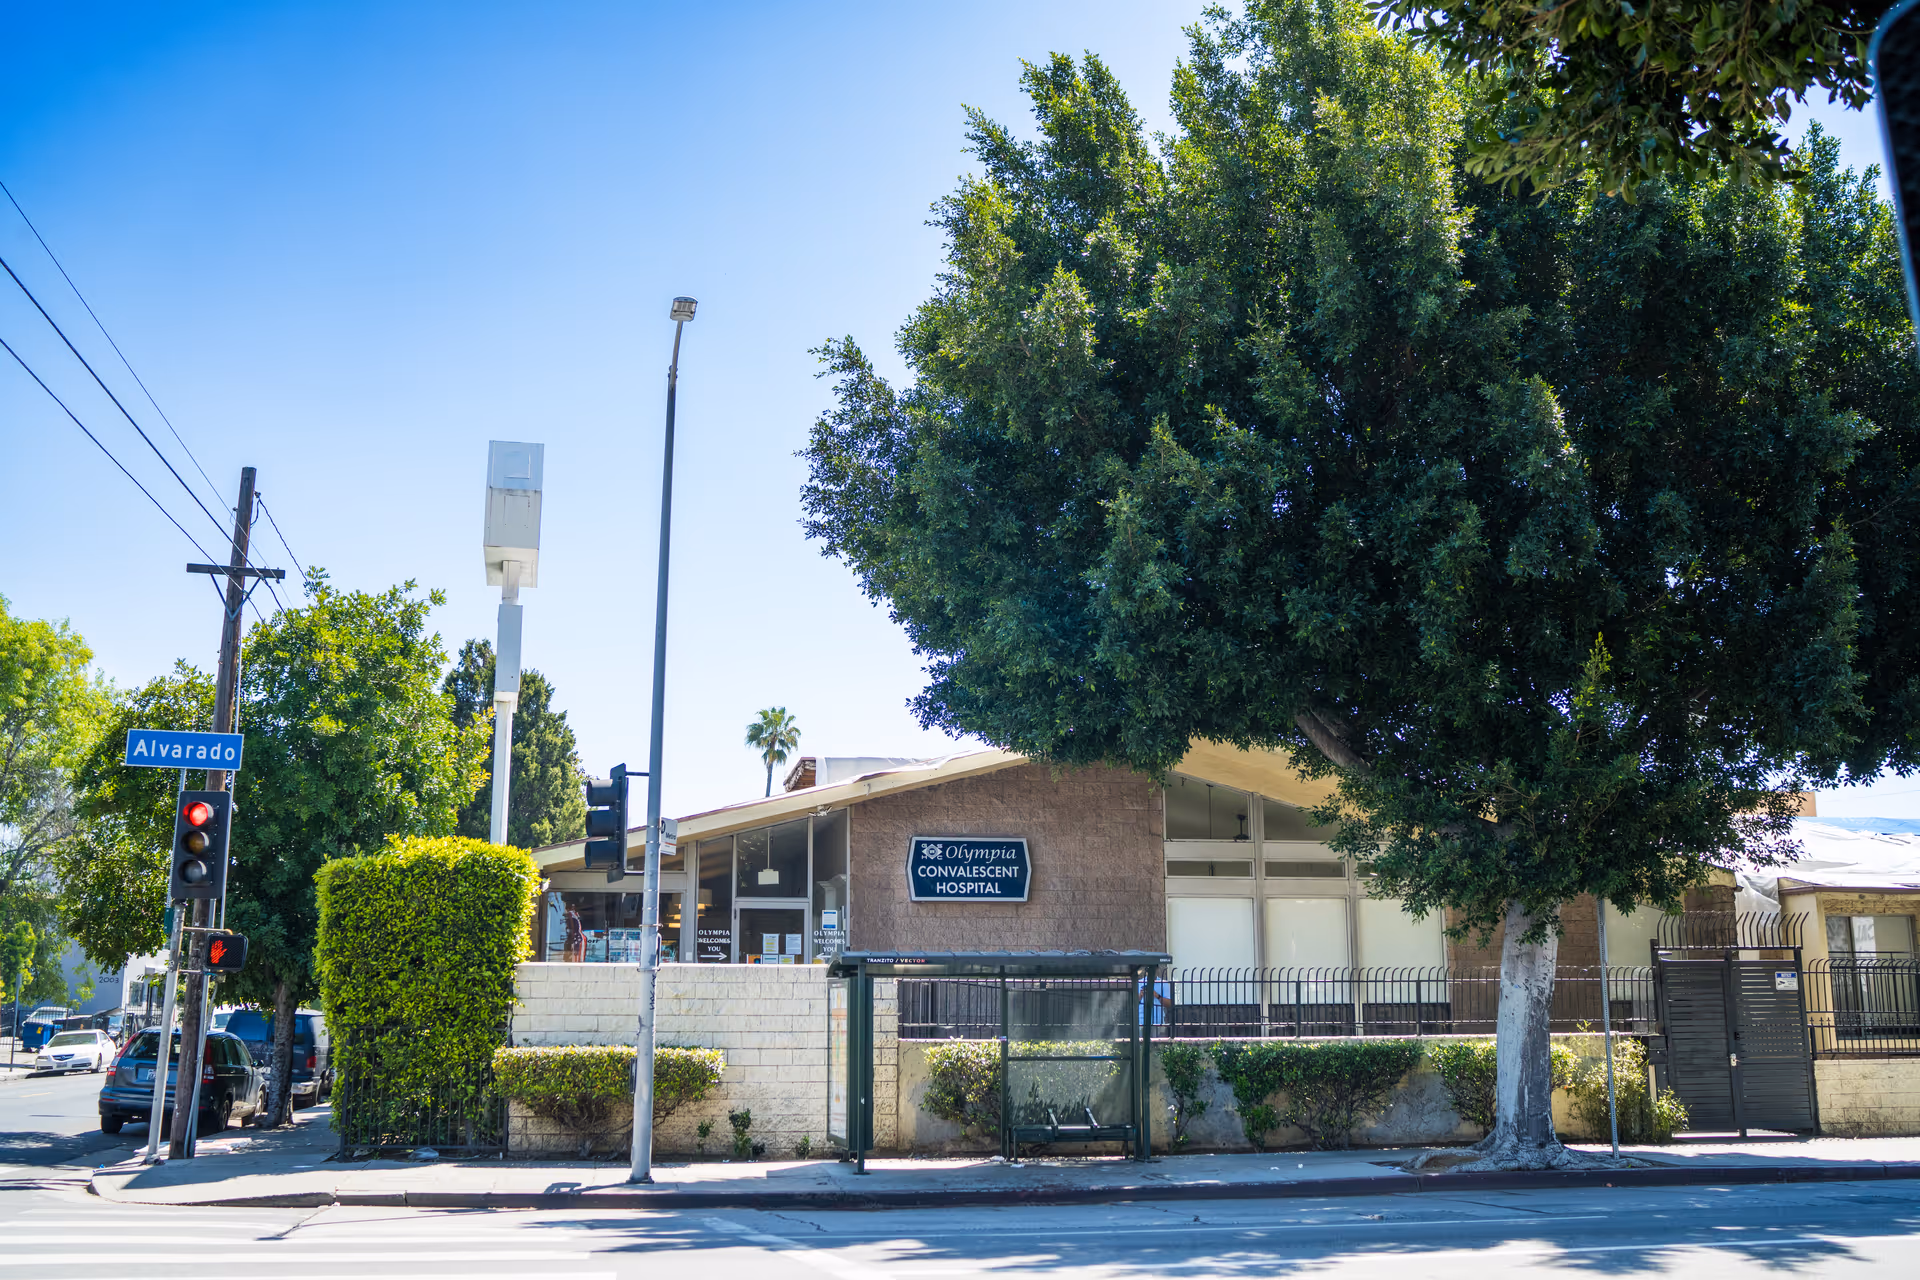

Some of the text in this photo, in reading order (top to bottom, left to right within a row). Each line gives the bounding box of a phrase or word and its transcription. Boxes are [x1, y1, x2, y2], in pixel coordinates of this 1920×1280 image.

[133, 739, 235, 761] Alvarado
[945, 843, 1017, 864] Olympia
[917, 865, 1019, 878] CONVALESCENT
[936, 882, 1001, 894] HOSPITAL
[98, 976, 119, 984] 2003
